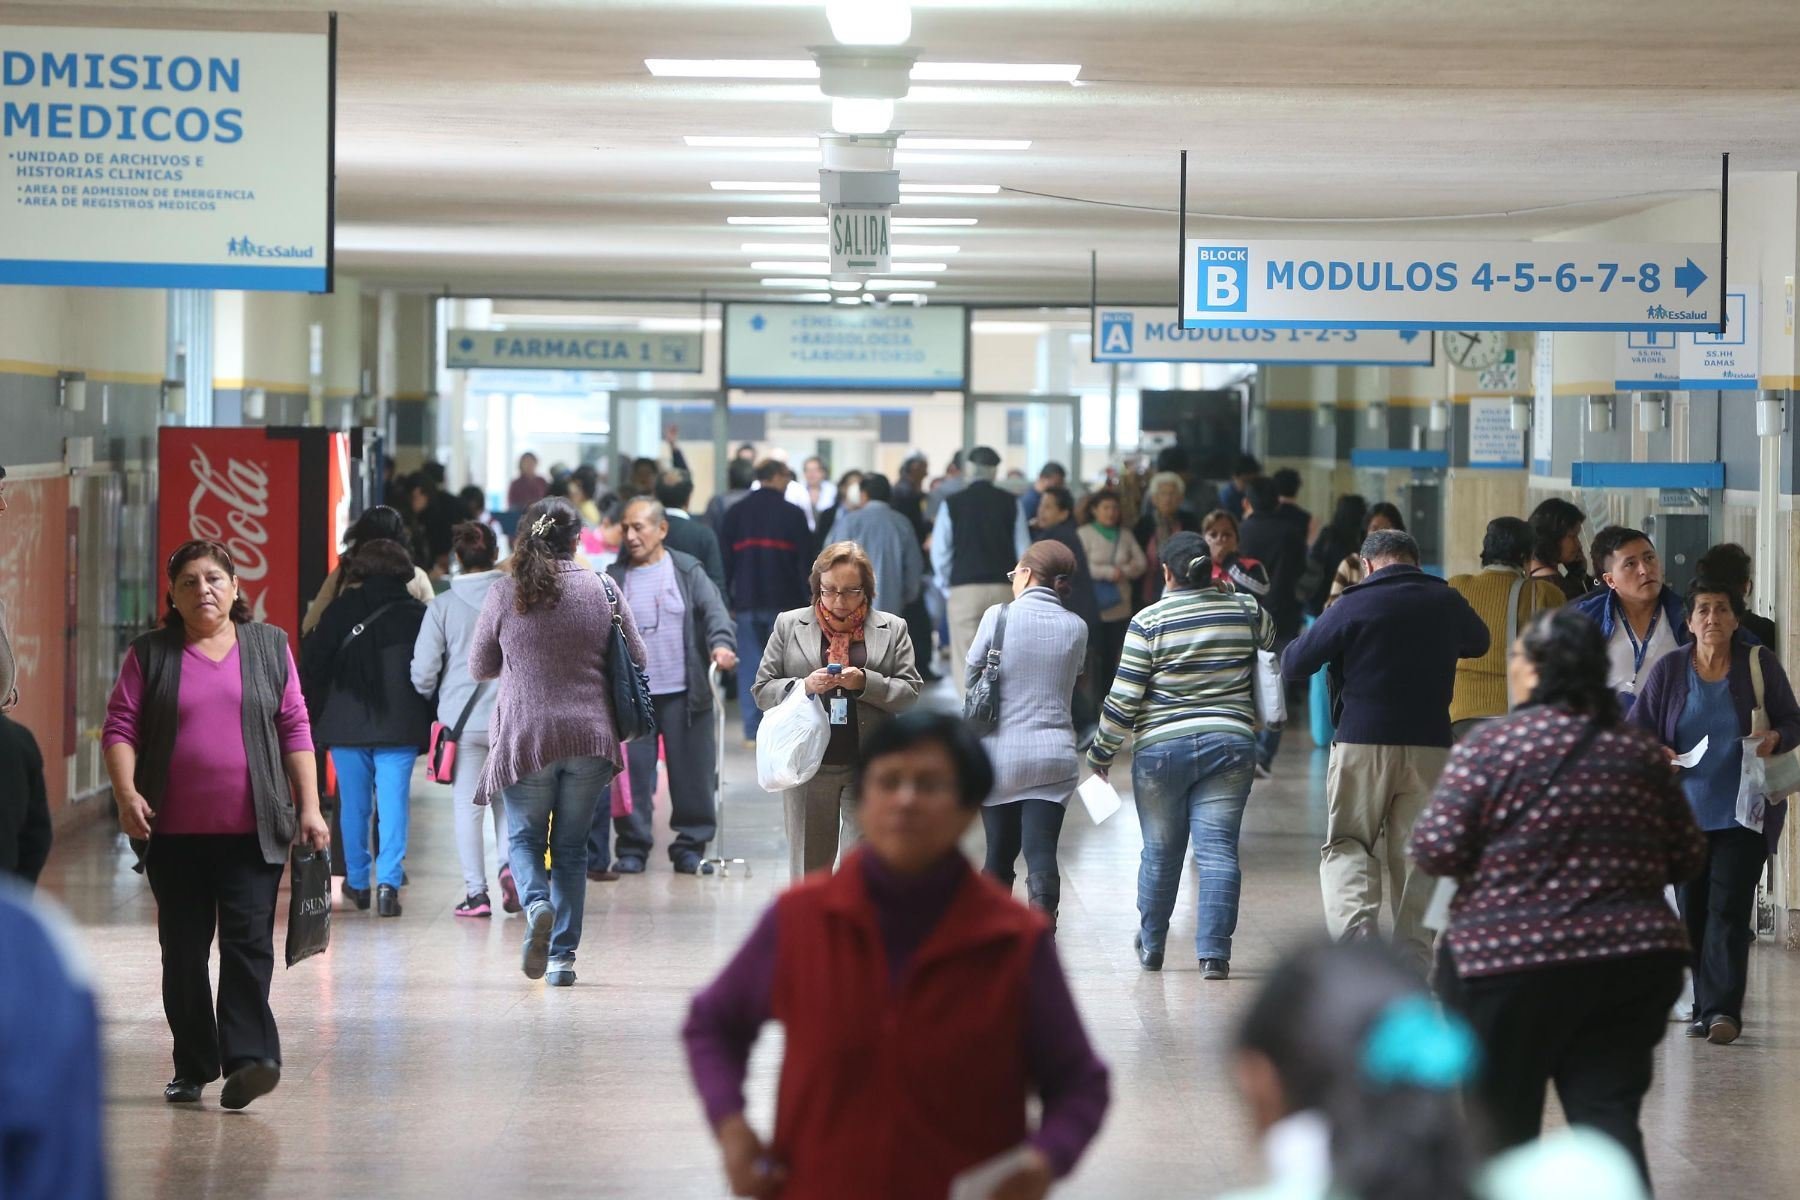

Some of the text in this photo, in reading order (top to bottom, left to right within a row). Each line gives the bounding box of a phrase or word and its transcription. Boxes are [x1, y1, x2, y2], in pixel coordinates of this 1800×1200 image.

[2, 50, 241, 93] DMISION
[3, 101, 244, 144] MEDICOS
[17, 151, 204, 167] UNIDAD DE ARCHIVOS E
[16, 166, 183, 181] HISTORIAS CLINICAS
[24, 184, 256, 201] AREA DE ADMISION DE EMERGENCIA
[24, 196, 217, 212] AREA DE REGISTROS MEDICOS
[834, 214, 889, 256] SALIDA
[257, 246, 314, 259] EsSalud
[1200, 249, 1247, 262] BLOCK
[1266, 260, 1662, 294] MODULOS 4-5-6-7-8
[1206, 265, 1241, 307] B
[1668, 310, 1708, 320] EsSalud
[1103, 322, 1132, 352] A
[493, 337, 630, 361] FARMACIA
[640, 343, 651, 363] 1
[1631, 356, 1667, 364] VARONES
[1704, 359, 1736, 367] DAMAS
[189, 442, 269, 582] Cola
